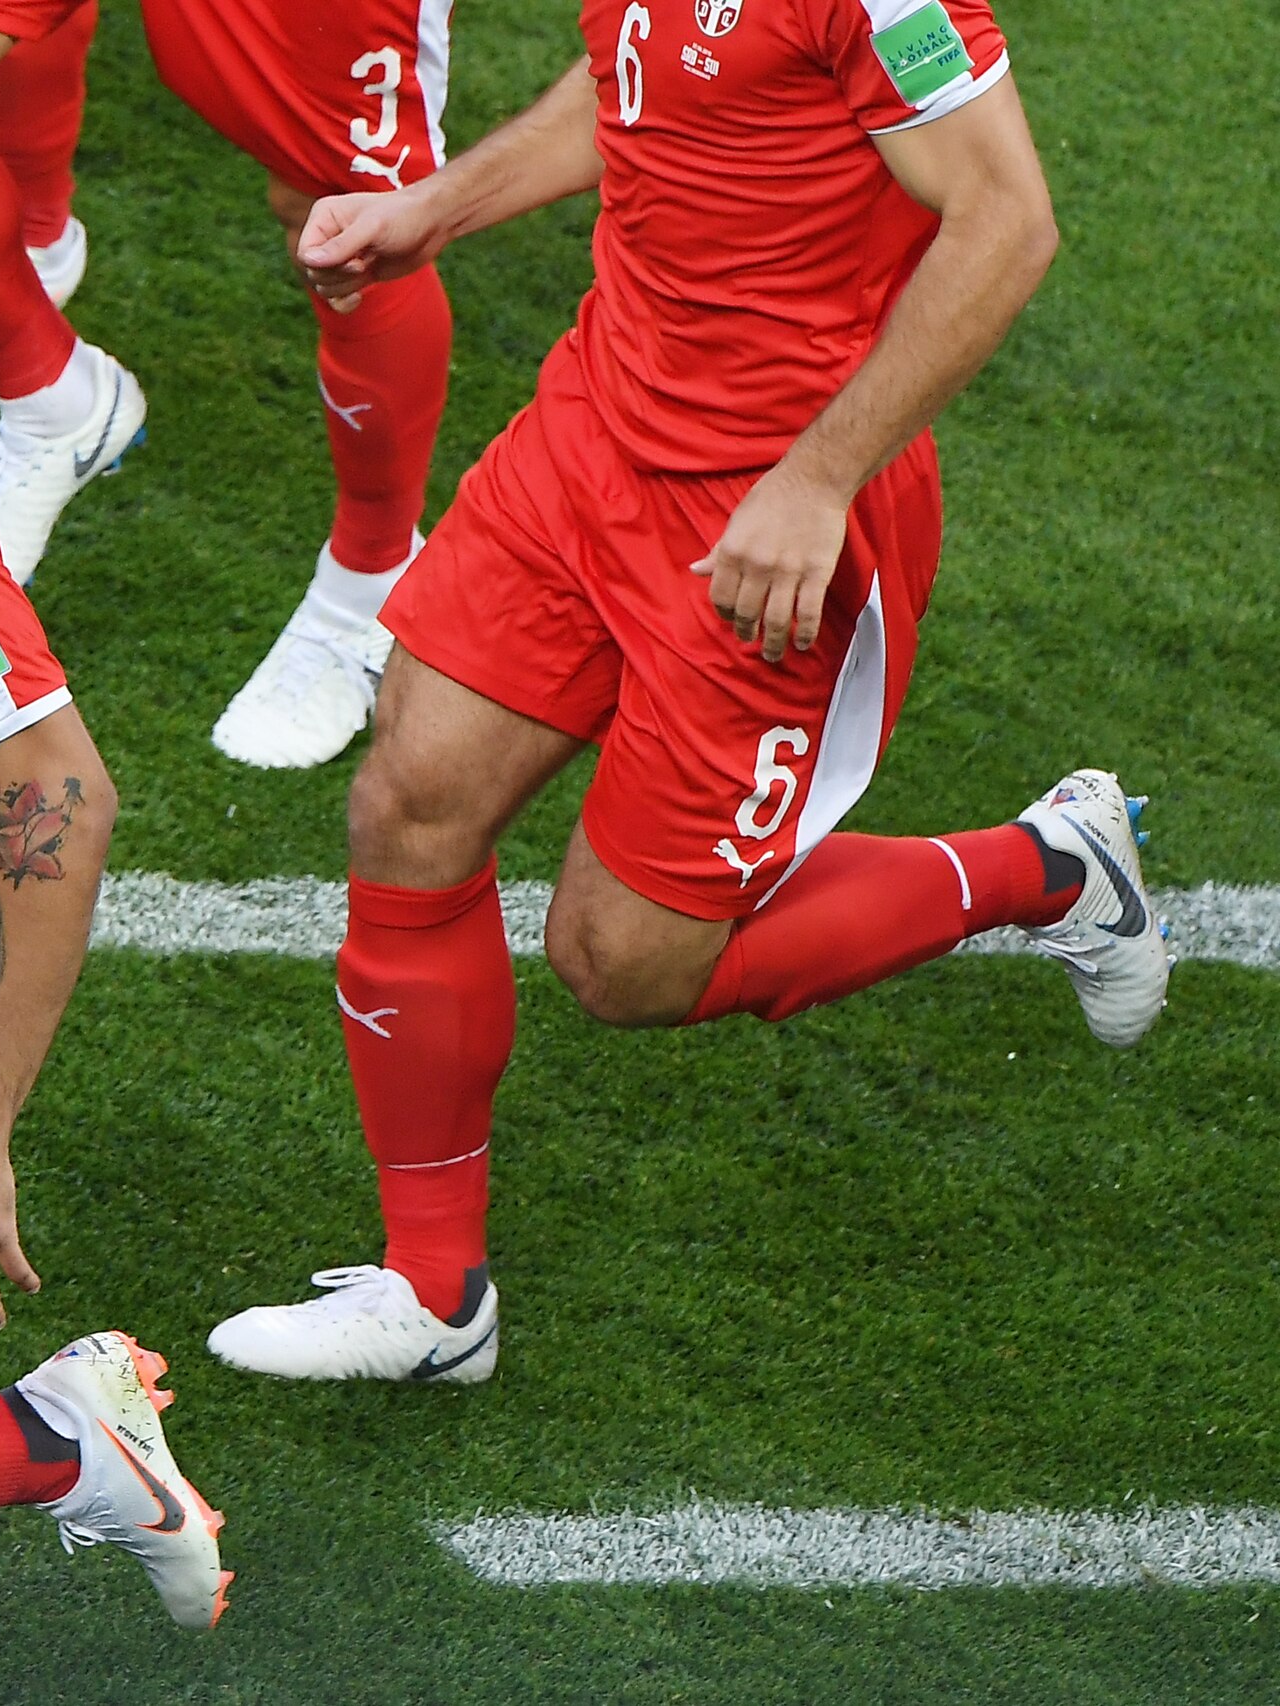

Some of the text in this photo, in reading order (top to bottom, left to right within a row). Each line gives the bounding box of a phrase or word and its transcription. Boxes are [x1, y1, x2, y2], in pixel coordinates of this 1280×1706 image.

[616, 1, 651, 127] 6
[887, 25, 947, 63] LIVING
[937, 48, 960, 67] FIFA
[349, 45, 401, 152] 3
[735, 725, 810, 840] 6
